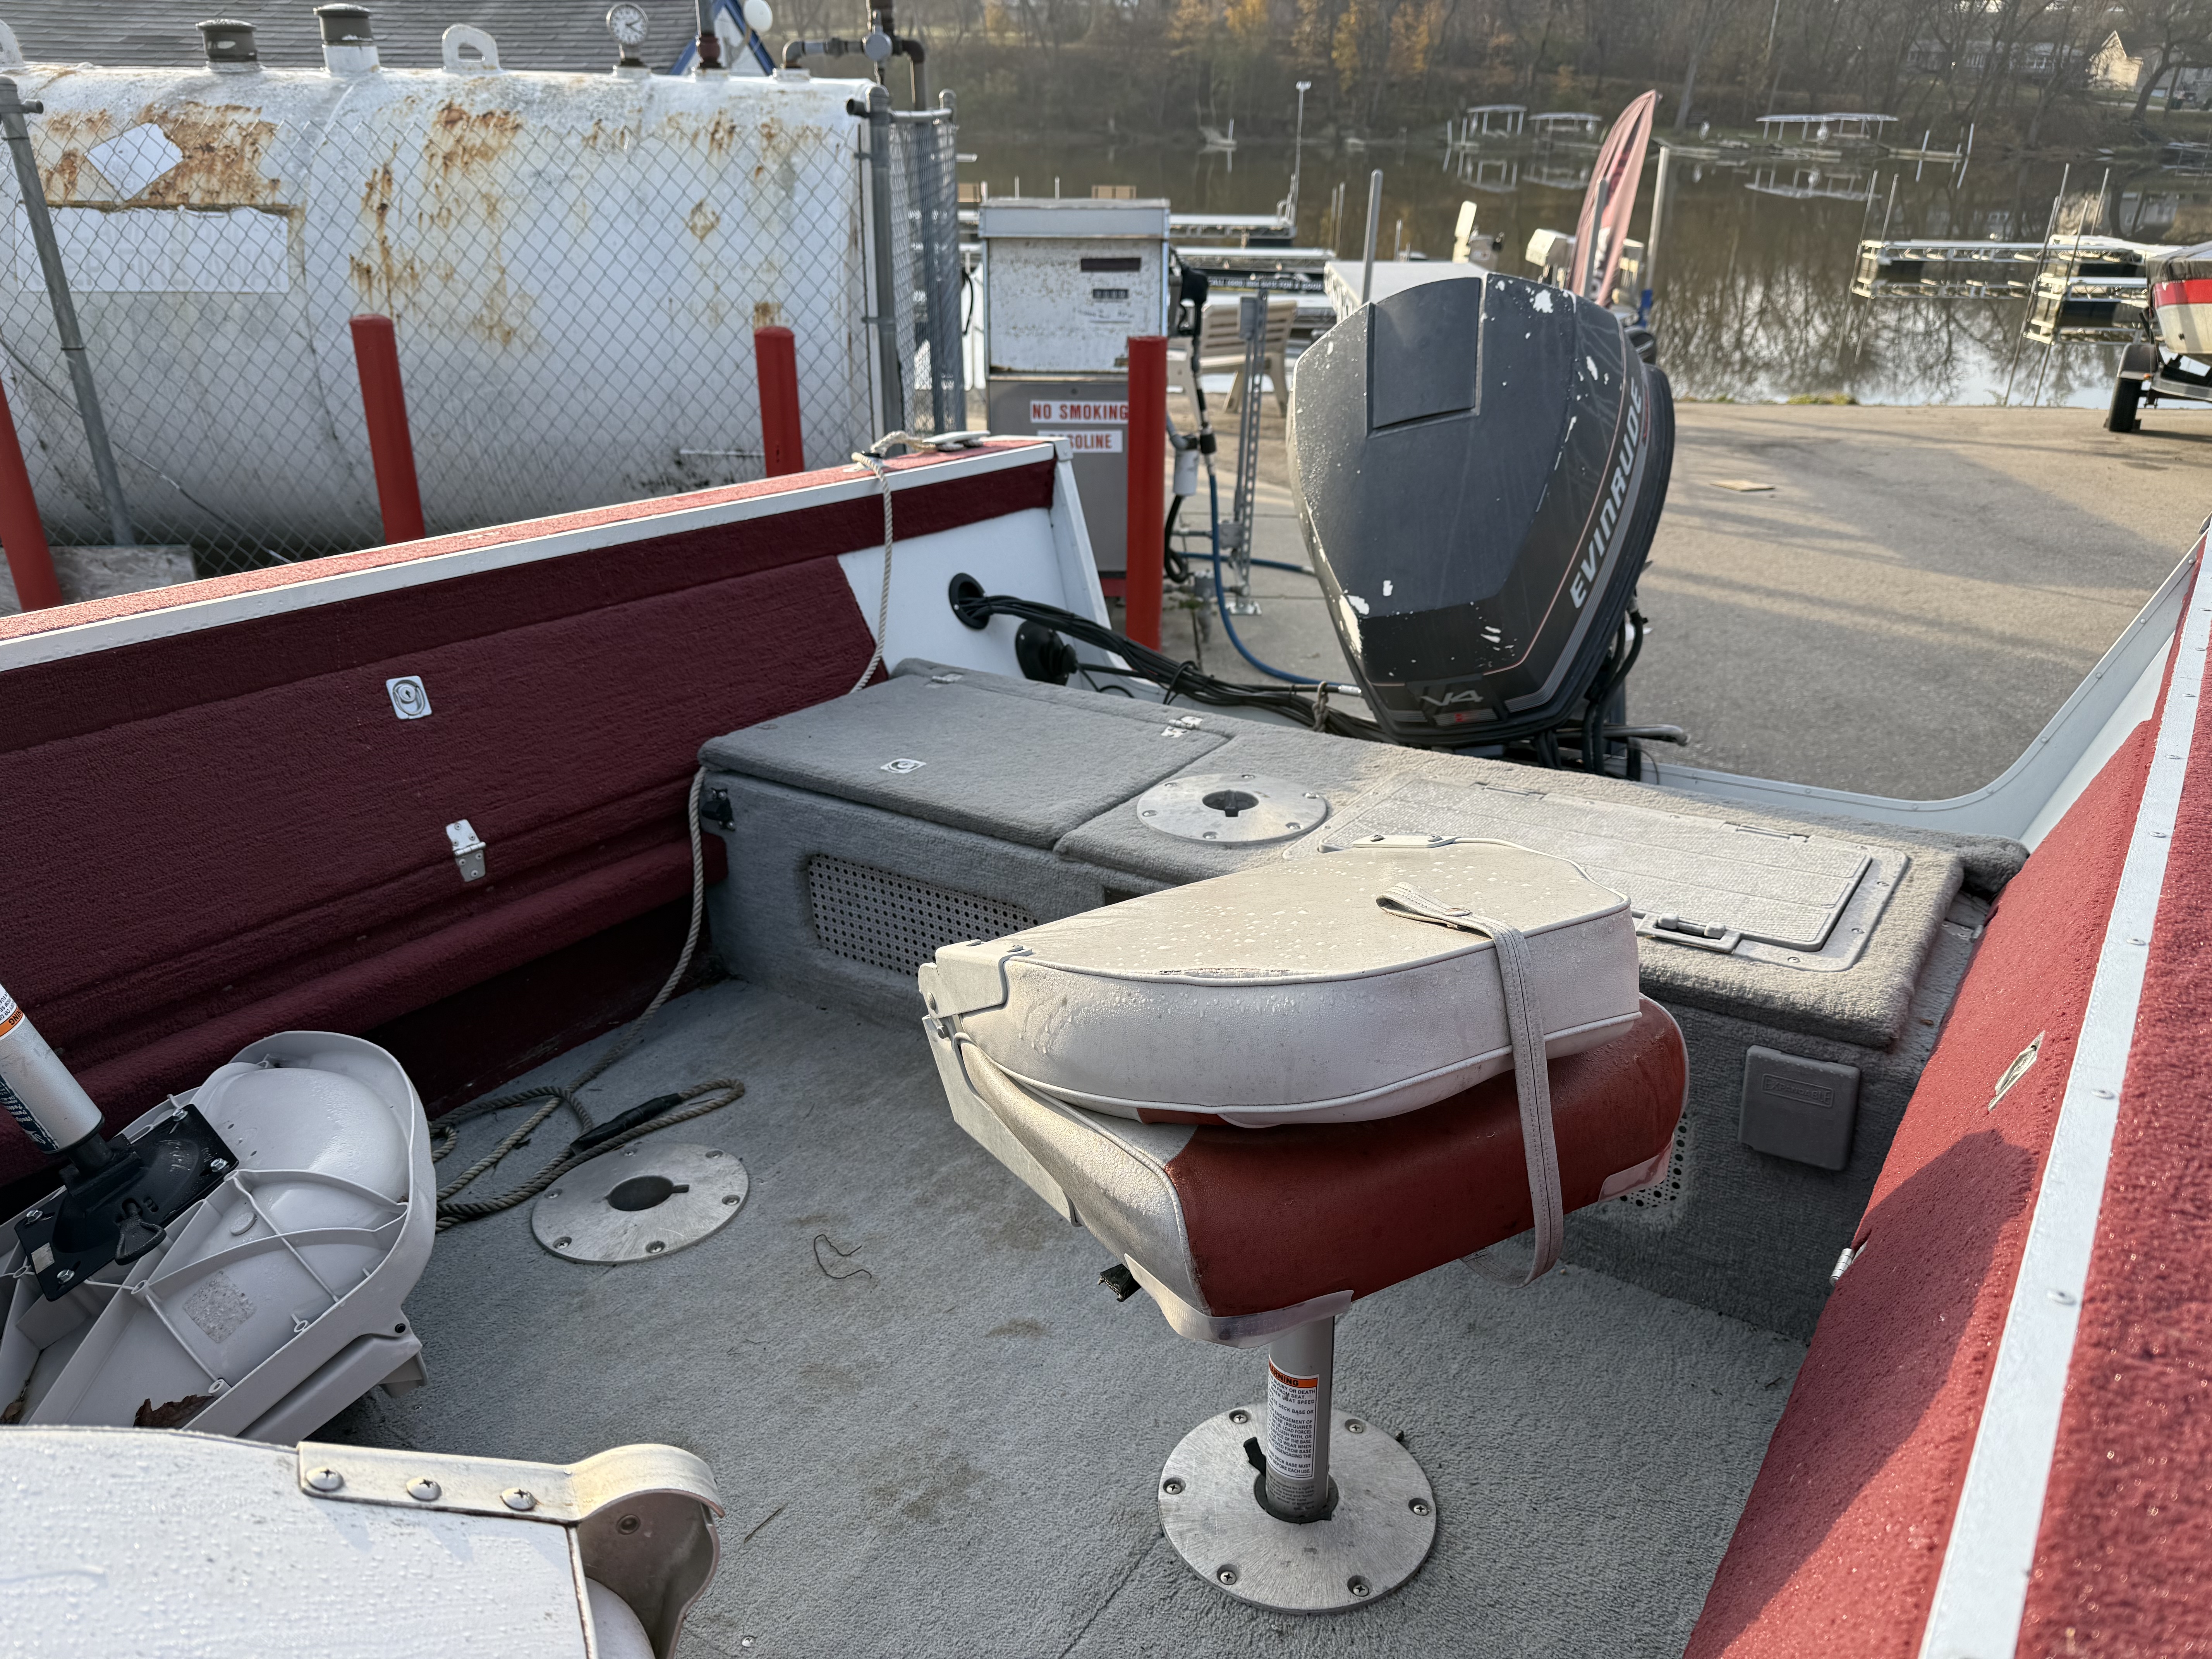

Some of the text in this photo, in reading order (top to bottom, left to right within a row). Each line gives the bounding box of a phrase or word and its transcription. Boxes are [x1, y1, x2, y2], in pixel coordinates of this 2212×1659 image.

[1033, 404, 1128, 420] NO SMOKING
[1049, 433, 1112, 449] SOLINE
[1570, 377, 1641, 608] EVINRUDE
[1420, 689, 1484, 706] V4
[1765, 1077, 1831, 1104] EXPANDABLE
[1277, 1387, 1290, 1396] FROM
[1279, 1403, 1290, 1412] DECK
[1273, 1460, 1287, 1471] BEFORE
[1274, 1455, 1285, 1463] DECK
